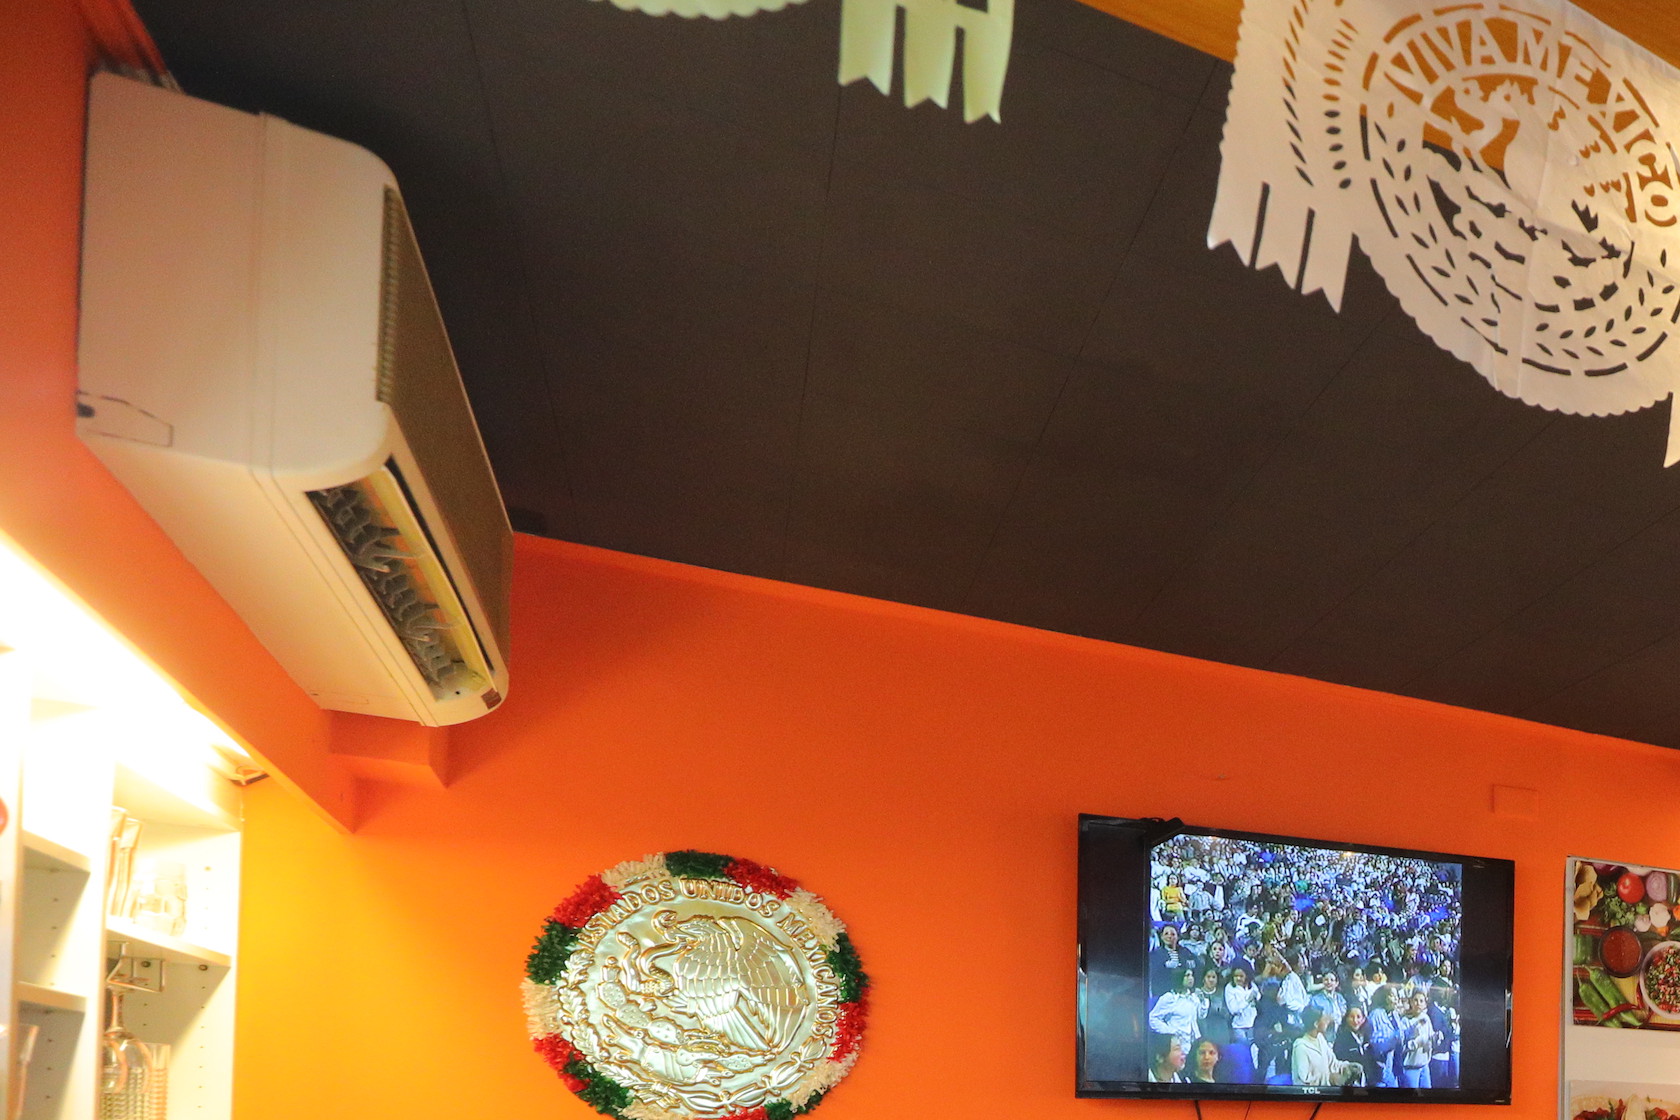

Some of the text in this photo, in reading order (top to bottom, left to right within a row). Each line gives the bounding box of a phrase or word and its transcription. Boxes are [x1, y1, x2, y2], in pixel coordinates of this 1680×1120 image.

[1384, 19, 1679, 228] VIVA MEXICO
[577, 877, 840, 1039] ESTADOS UNIDOS MEXICANOS
[1301, 1086, 1320, 1094] TCL
